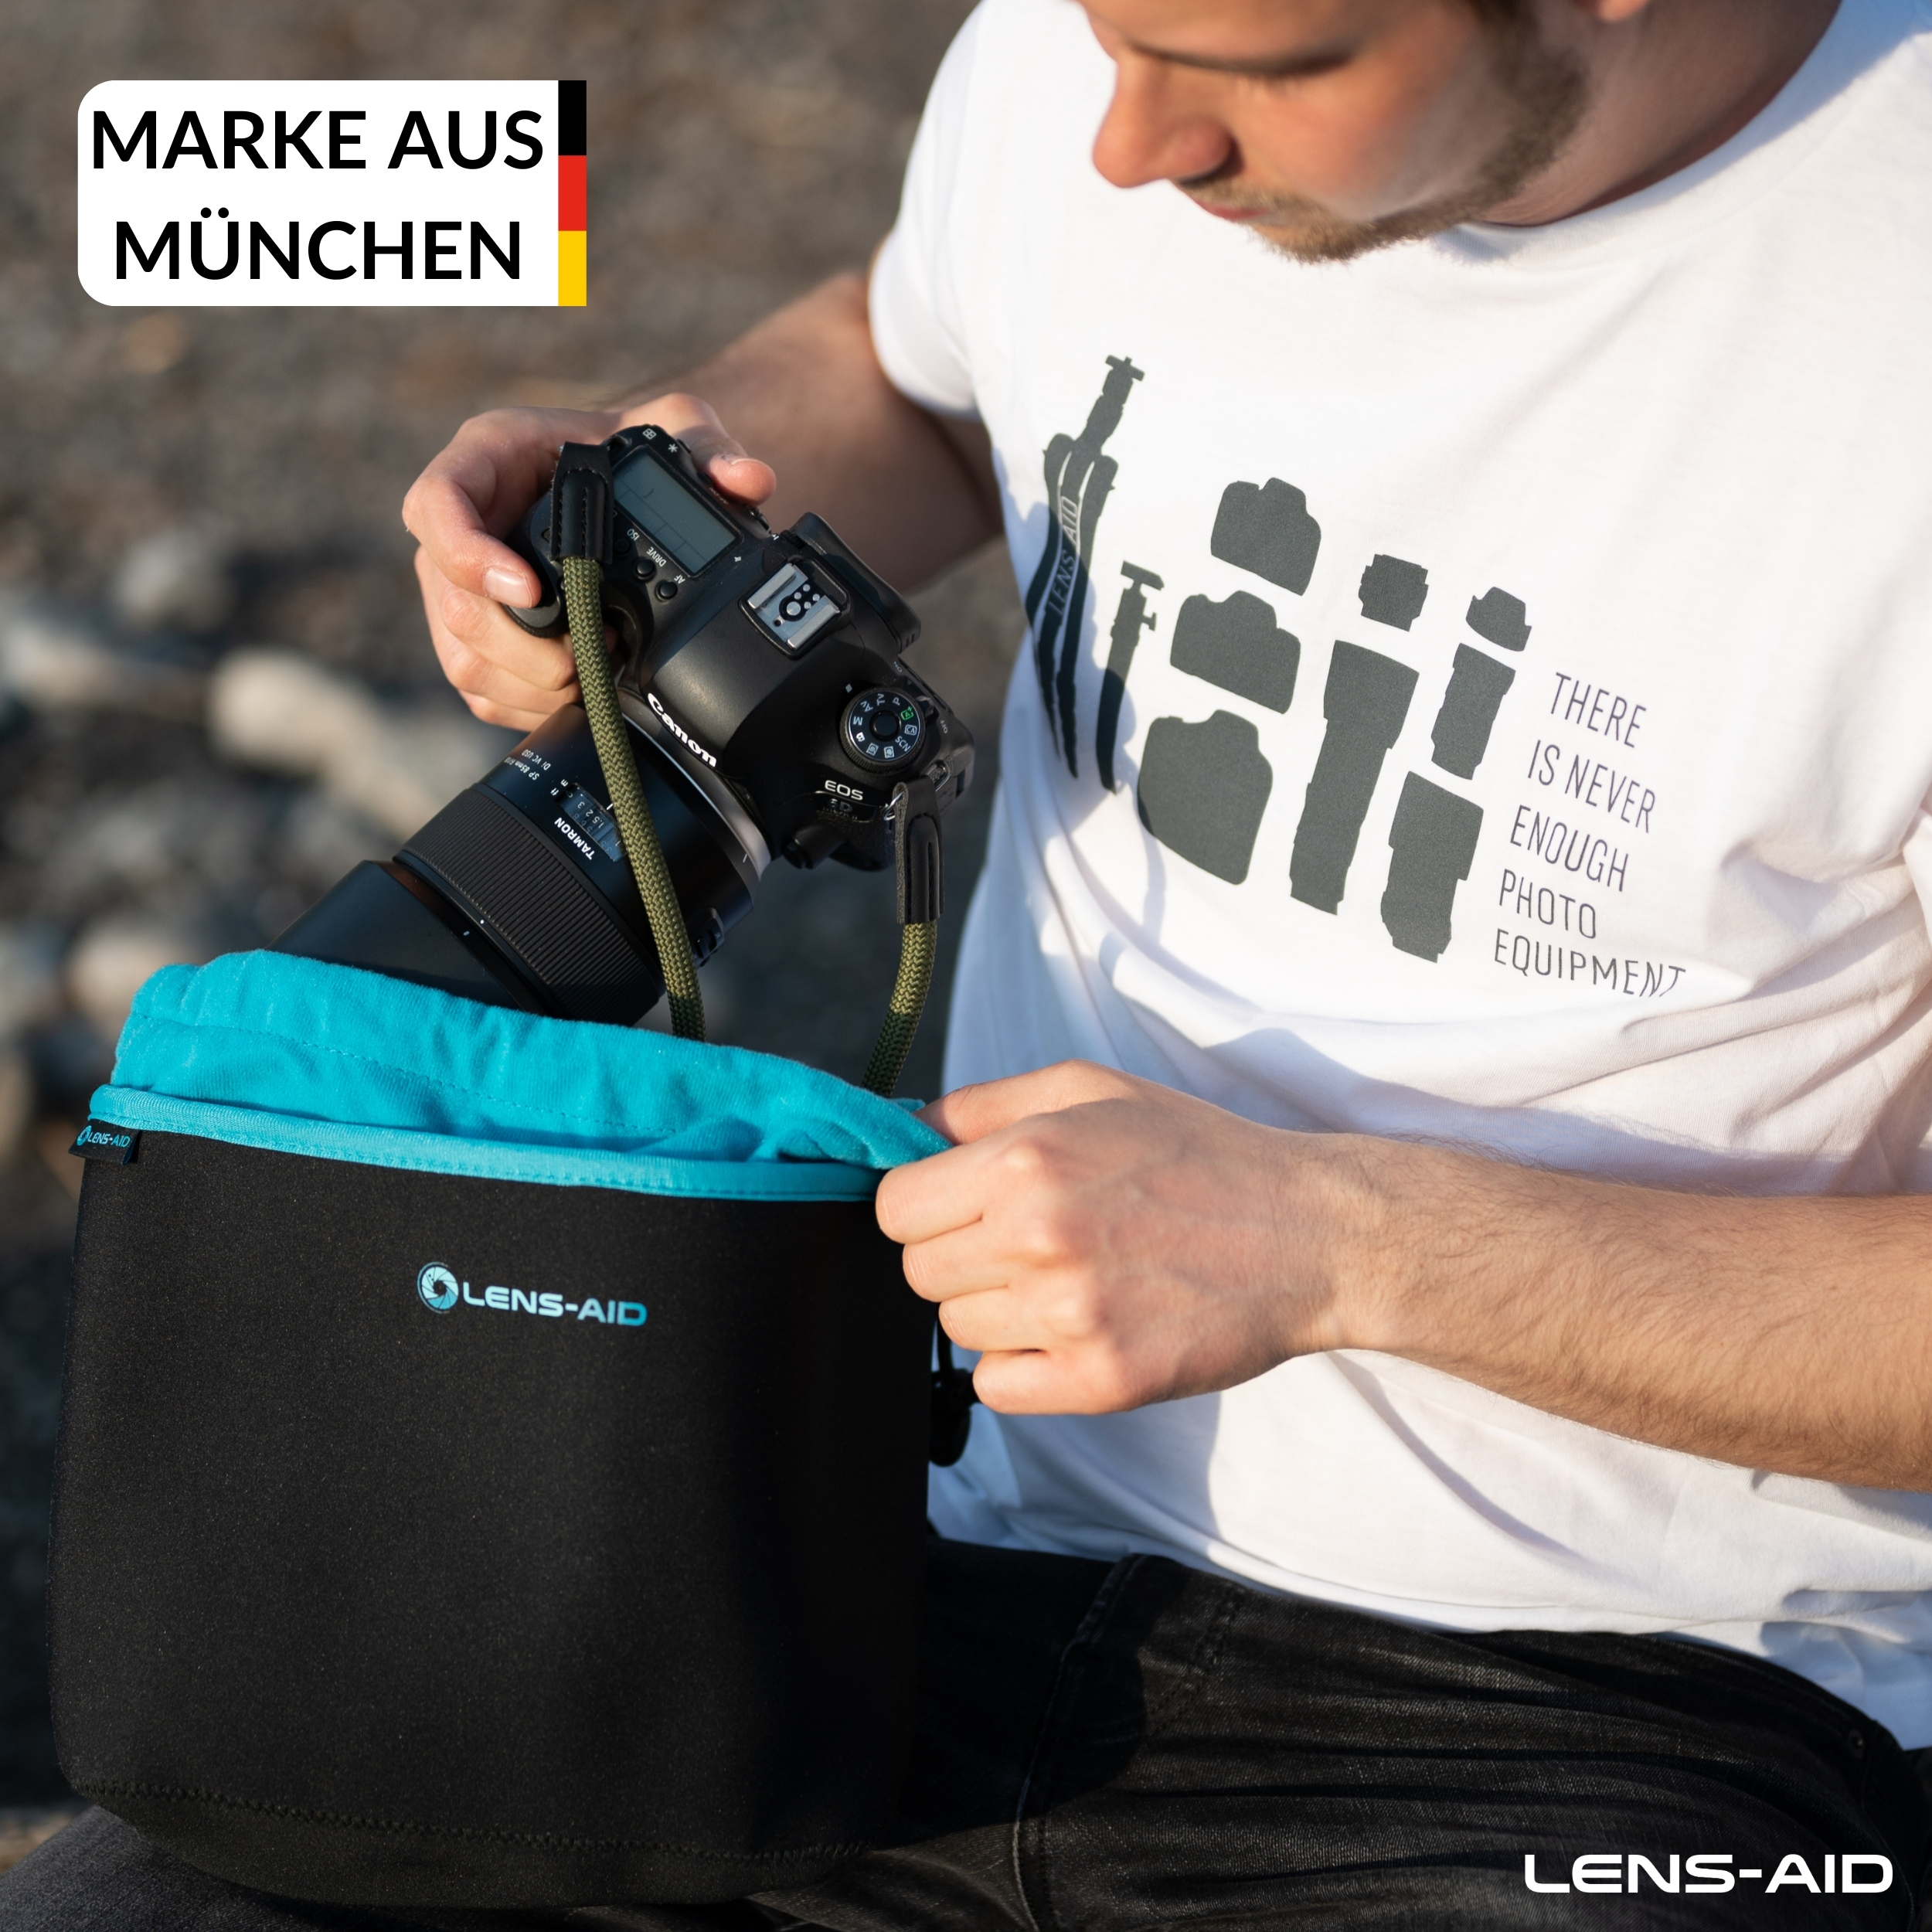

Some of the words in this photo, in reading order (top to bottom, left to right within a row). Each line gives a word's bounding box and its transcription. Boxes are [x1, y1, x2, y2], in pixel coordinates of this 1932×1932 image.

[1061, 495, 1078, 546] AID
[627, 528, 640, 541] ISO
[646, 546, 667, 567] DRIVE
[673, 574, 686, 584] AF
[892, 696, 901, 706] P
[1550, 671, 1647, 749] THERE
[852, 716, 863, 726] M
[648, 692, 717, 767] Canon
[855, 732, 866, 743] B
[895, 736, 911, 752] SCN
[521, 748, 535, 760] USD
[531, 754, 543, 764] VC
[540, 760, 552, 771] Di
[528, 770, 540, 781] SP
[824, 780, 863, 801] EOS
[1527, 739, 1560, 786] IS
[1564, 754, 1656, 834] NEVER
[577, 801, 585, 809] 3
[585, 808, 594, 817] 2
[592, 815, 605, 828] 1.5
[554, 816, 596, 860] TAMRON
[1509, 804, 1629, 893] ENOUGH
[1498, 868, 1597, 940] PHOTO
[1494, 927, 1686, 998] EQUIPMENT
[87, 1131, 131, 1148] LENS-AID
[462, 1281, 648, 1327] LENS-AID
